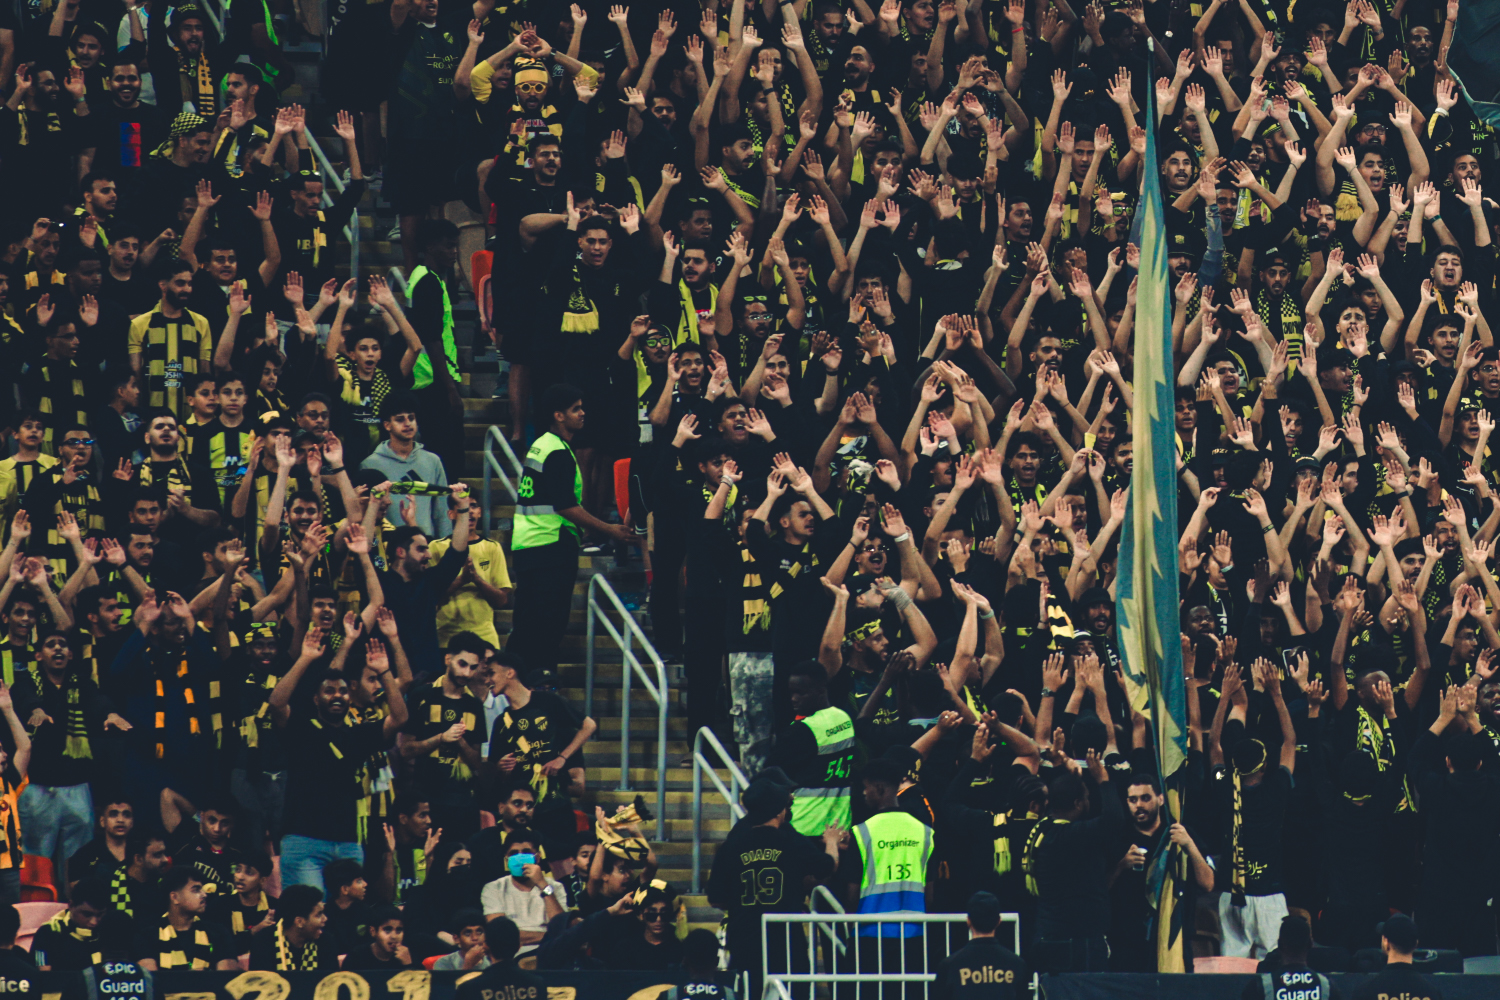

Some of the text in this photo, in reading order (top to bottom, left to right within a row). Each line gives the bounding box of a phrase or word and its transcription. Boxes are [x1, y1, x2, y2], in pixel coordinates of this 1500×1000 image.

[877, 837, 920, 850] Organizer
[740, 848, 782, 866] DIABY
[887, 863, 912, 881] 135
[740, 866, 784, 906] 19
[104, 963, 136, 975] EPIC
[959, 966, 1015, 986] Police
[0, 977, 30, 993] ice
[100, 979, 145, 994] Guard
[1281, 972, 1314, 986] EPIC
[481, 984, 537, 1000] Police
[684, 984, 719, 996] EPIC
[1276, 985, 1320, 1000] Guard
